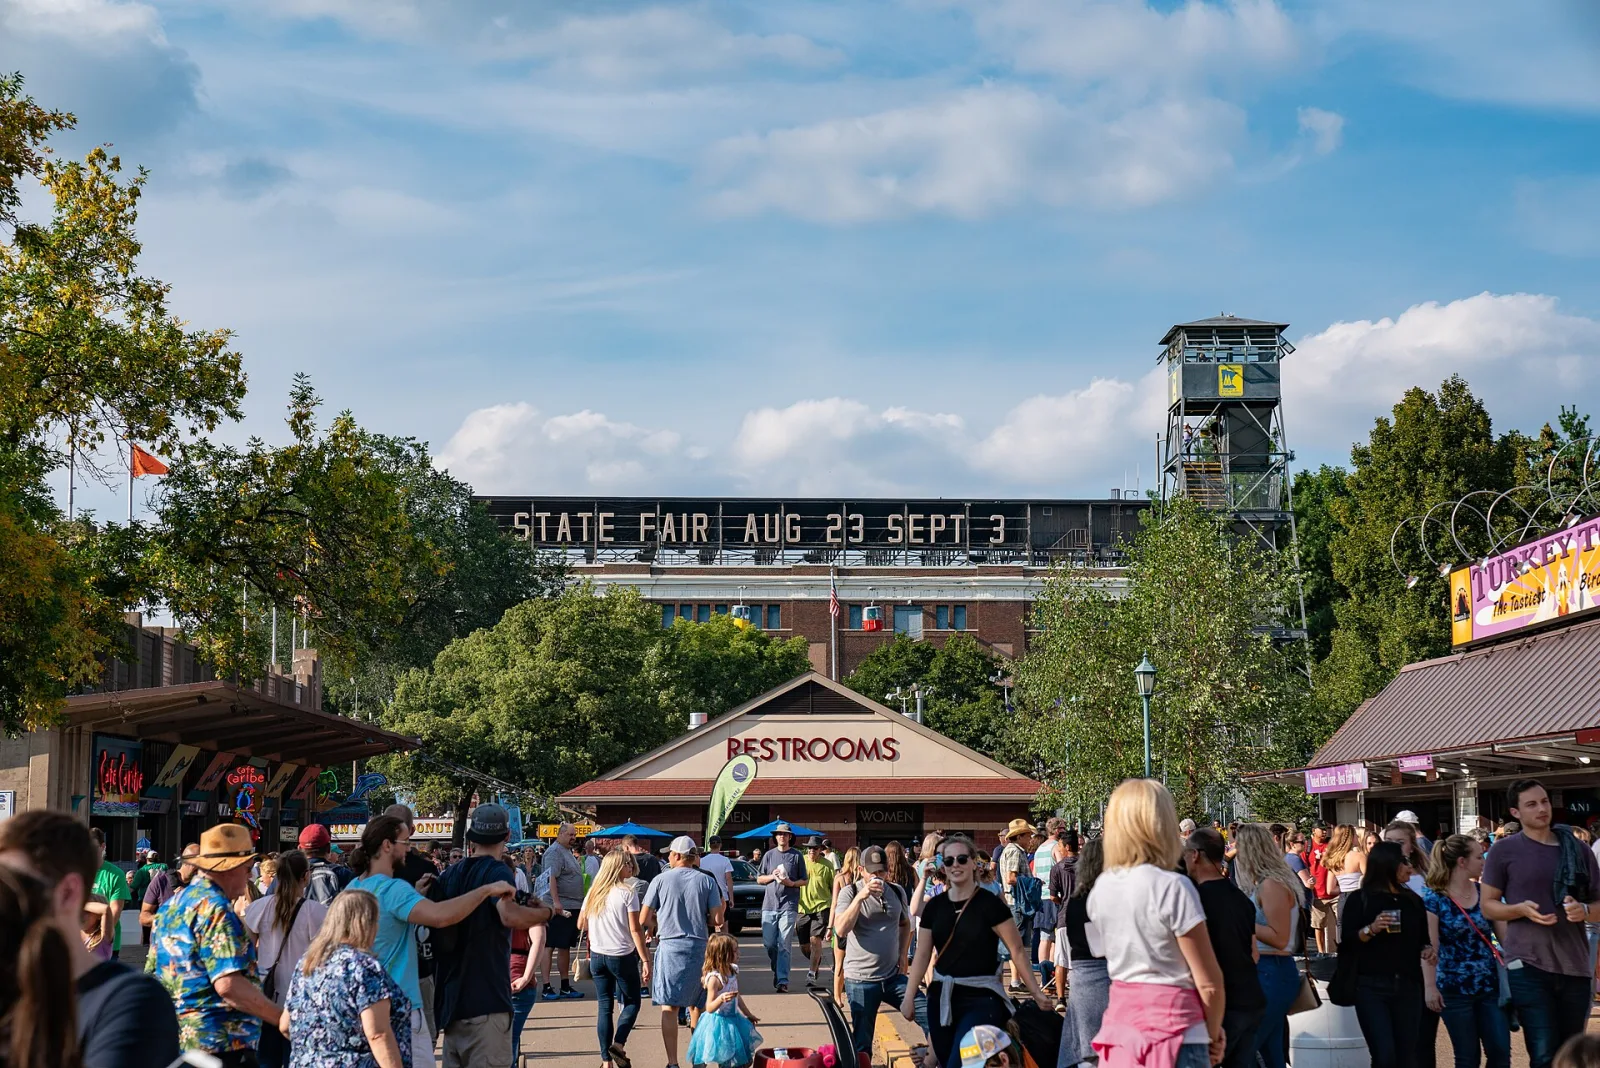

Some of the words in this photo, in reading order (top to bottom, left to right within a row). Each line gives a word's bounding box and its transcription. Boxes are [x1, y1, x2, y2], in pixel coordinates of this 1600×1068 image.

[514, 512, 615, 542] STATE
[639, 512, 708, 543] FAIR
[743, 513, 801, 543] AUG
[826, 513, 864, 543] 23
[887, 513, 965, 543] SEPT
[989, 514, 1005, 544] 3
[1471, 532, 1573, 602] TURKEY
[1577, 523, 1600, 553] T
[1510, 588, 1547, 612] Tastiest
[727, 737, 899, 762] RESTROOMS
[227, 773, 265, 785] Caribe
[859, 810, 914, 822] WOMEN
[331, 824, 358, 834] INY
[416, 823, 453, 833] ONUT
[574, 827, 592, 835] BEER
